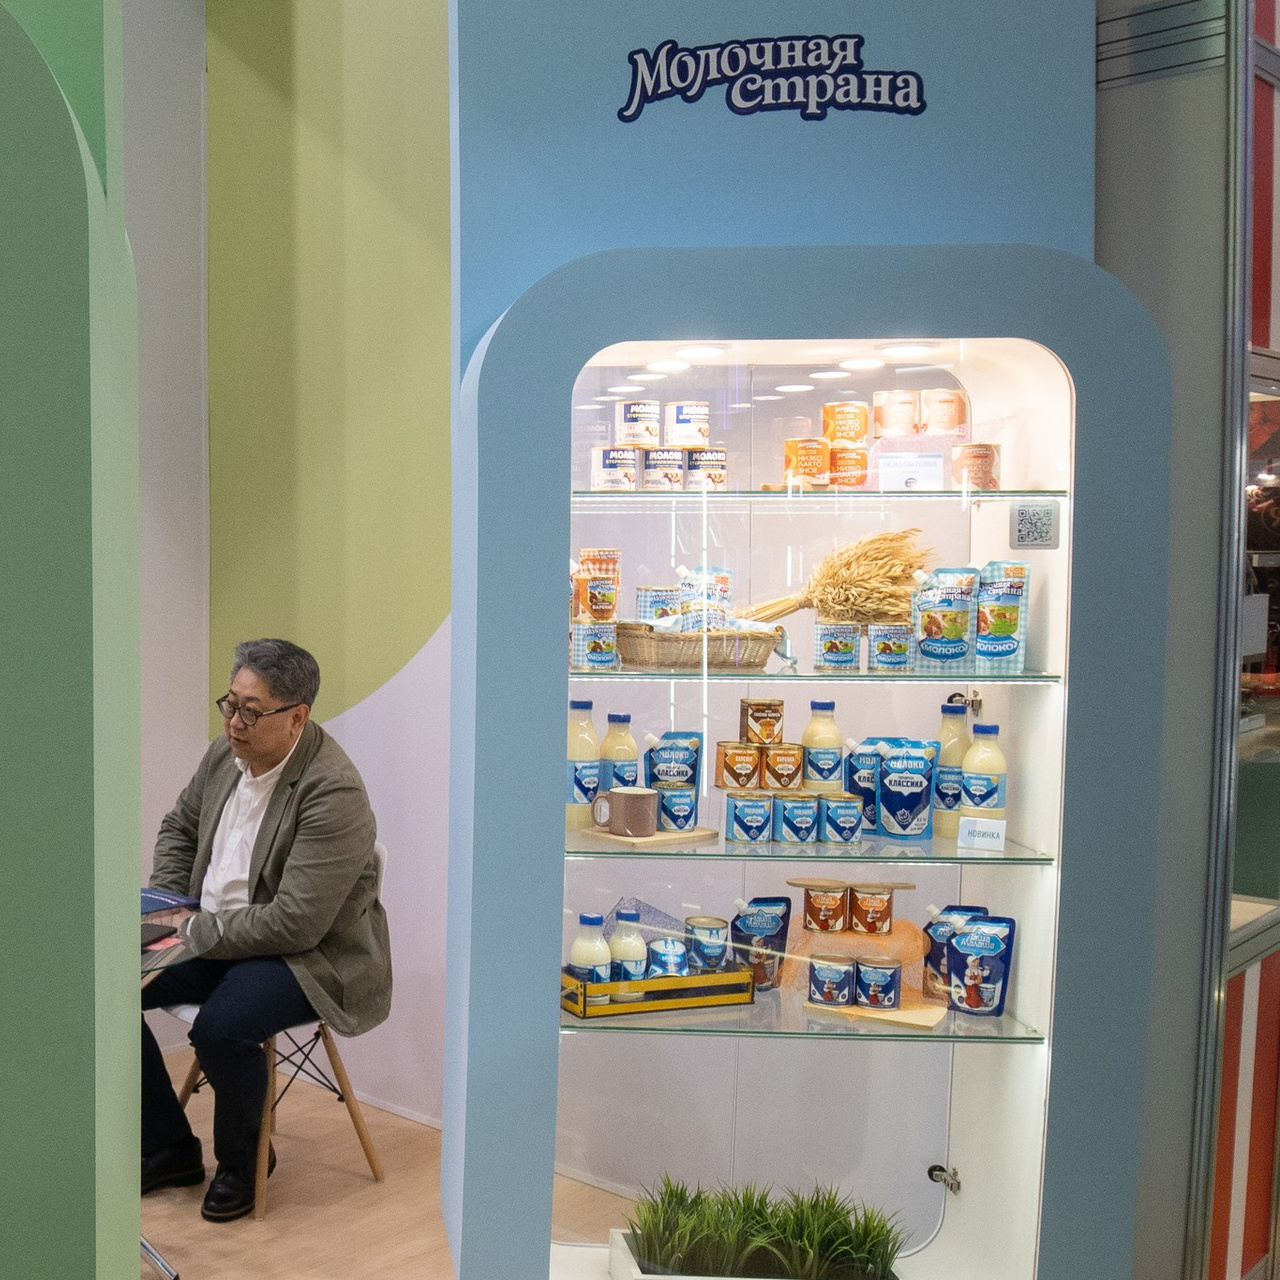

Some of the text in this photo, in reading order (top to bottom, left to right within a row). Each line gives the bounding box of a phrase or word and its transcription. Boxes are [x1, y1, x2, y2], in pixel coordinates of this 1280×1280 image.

[623, 37, 860, 117] Молочная
[925, 646, 965, 654] МОЛОКО
[859, 756, 877, 764] МОЛ
[890, 760, 924, 769] МОЛОКО
[889, 779, 923, 788] КЛАССИКА
[967, 829, 1000, 840] НОВИНКА
